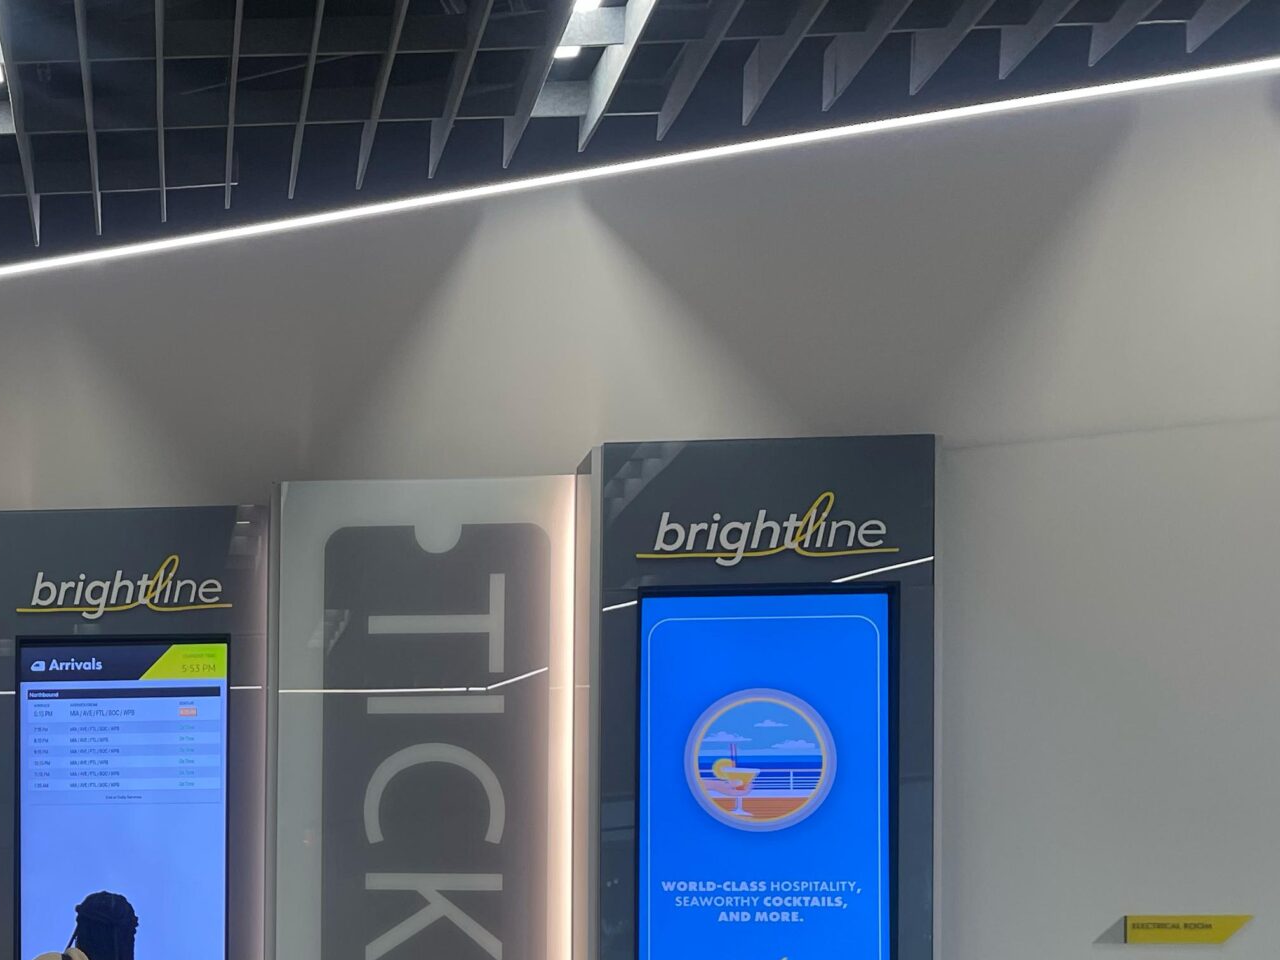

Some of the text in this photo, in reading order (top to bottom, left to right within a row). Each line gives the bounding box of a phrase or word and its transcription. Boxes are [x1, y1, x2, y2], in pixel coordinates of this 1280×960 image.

[654, 491, 887, 567] brightline
[31, 555, 223, 619] brightline
[48, 657, 103, 671] Arrivals
[182, 664, 216, 673] 5:53 PM
[661, 880, 862, 894] WORLD-CLASS HOSPITALITY,
[674, 896, 848, 909] SEAWORTHY COCKTAILS,
[717, 911, 804, 922] AND MORE.
